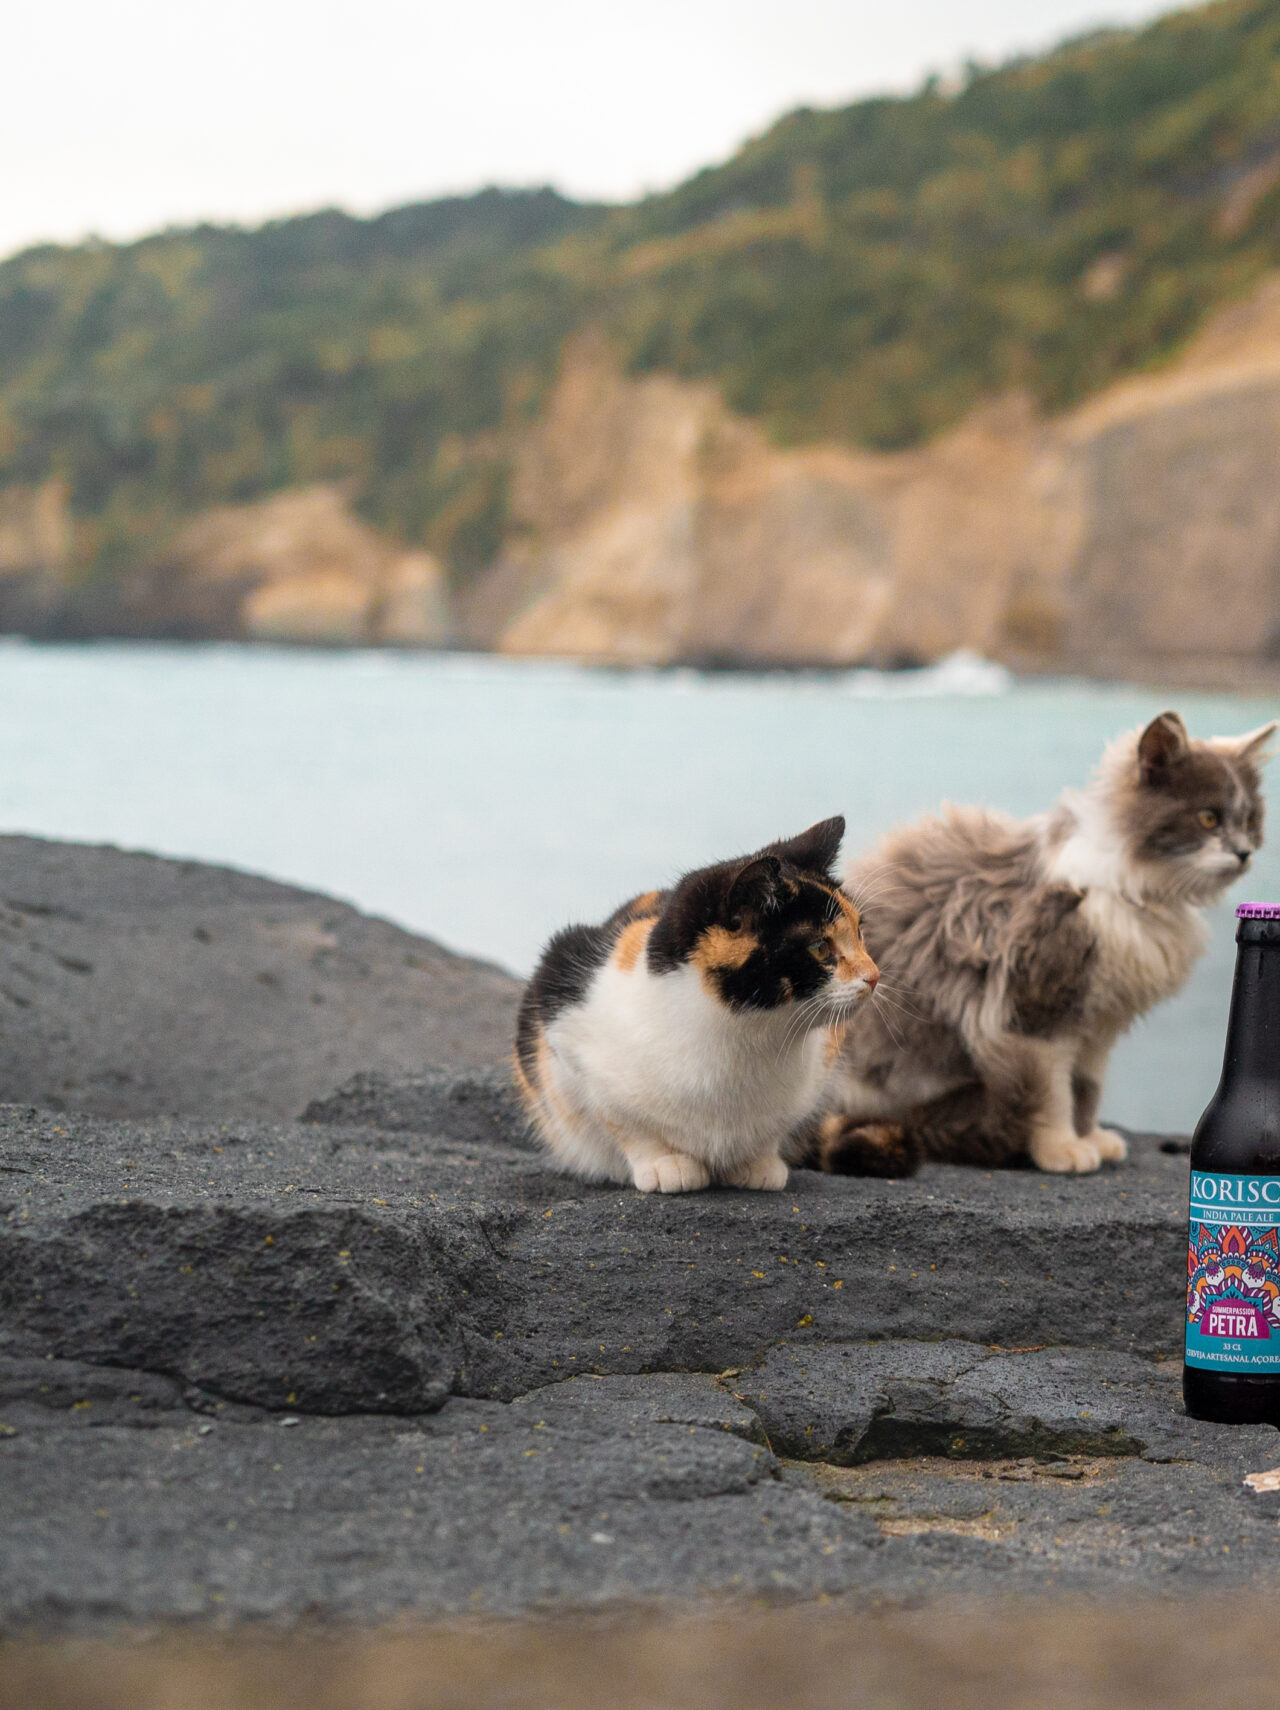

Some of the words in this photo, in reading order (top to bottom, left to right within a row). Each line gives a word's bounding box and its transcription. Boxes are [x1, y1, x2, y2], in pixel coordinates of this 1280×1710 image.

[1203, 1209, 1228, 1220] INDIA
[1230, 1211, 1253, 1222] PALE
[1256, 1213, 1274, 1222] ALE
[1211, 1305, 1232, 1315] SUMMER
[1233, 1307, 1255, 1316] PASSION
[1209, 1313, 1259, 1337] PETRA
[1222, 1342, 1231, 1350] 33
[1206, 1352, 1249, 1363] ARTESANAL
